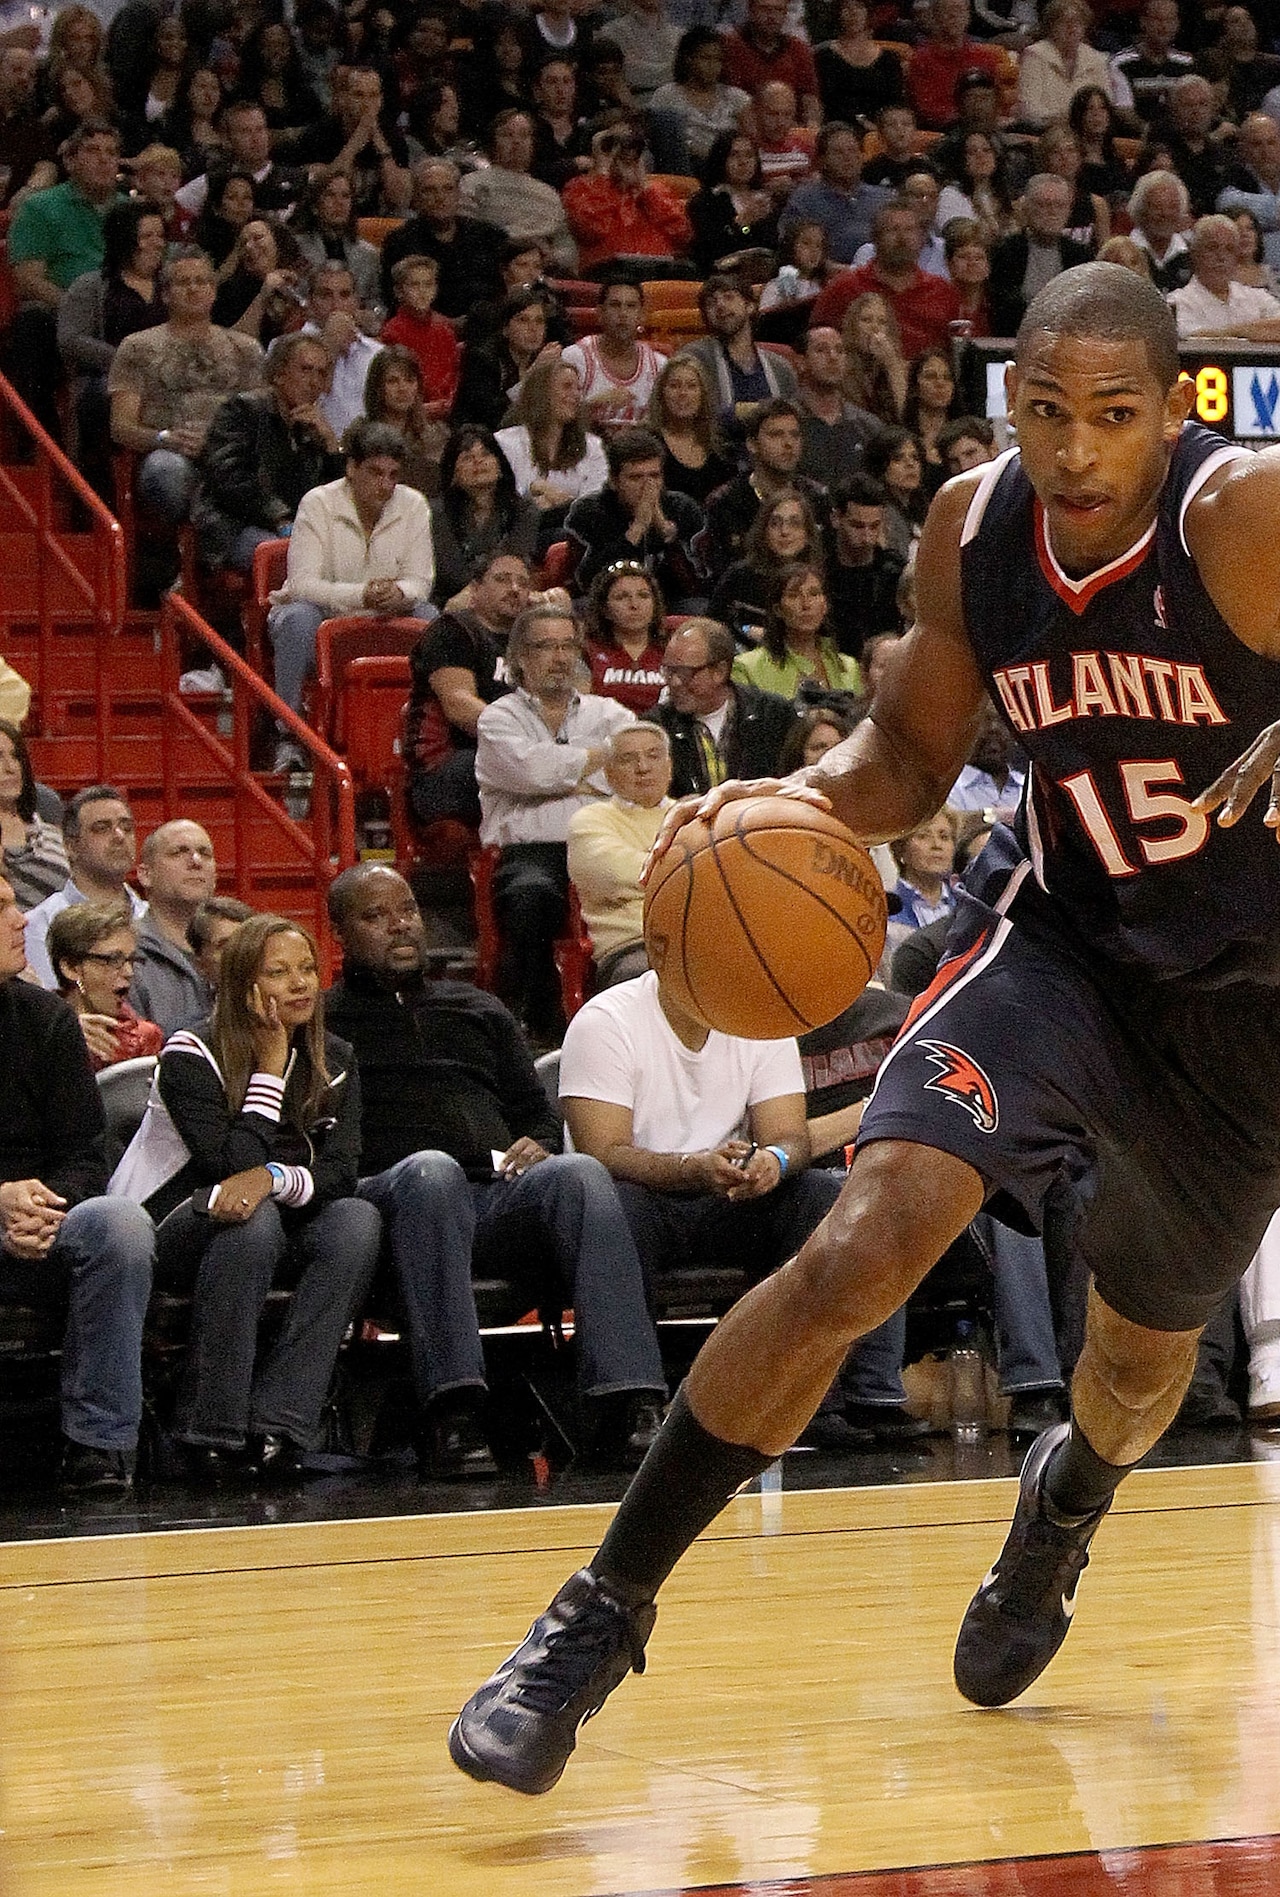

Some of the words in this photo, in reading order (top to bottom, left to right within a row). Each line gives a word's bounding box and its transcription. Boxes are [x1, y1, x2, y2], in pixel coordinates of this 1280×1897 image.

[603, 666, 667, 686] MIAM
[992, 650, 1231, 732] ATLANTA
[1058, 757, 1211, 878] 15
